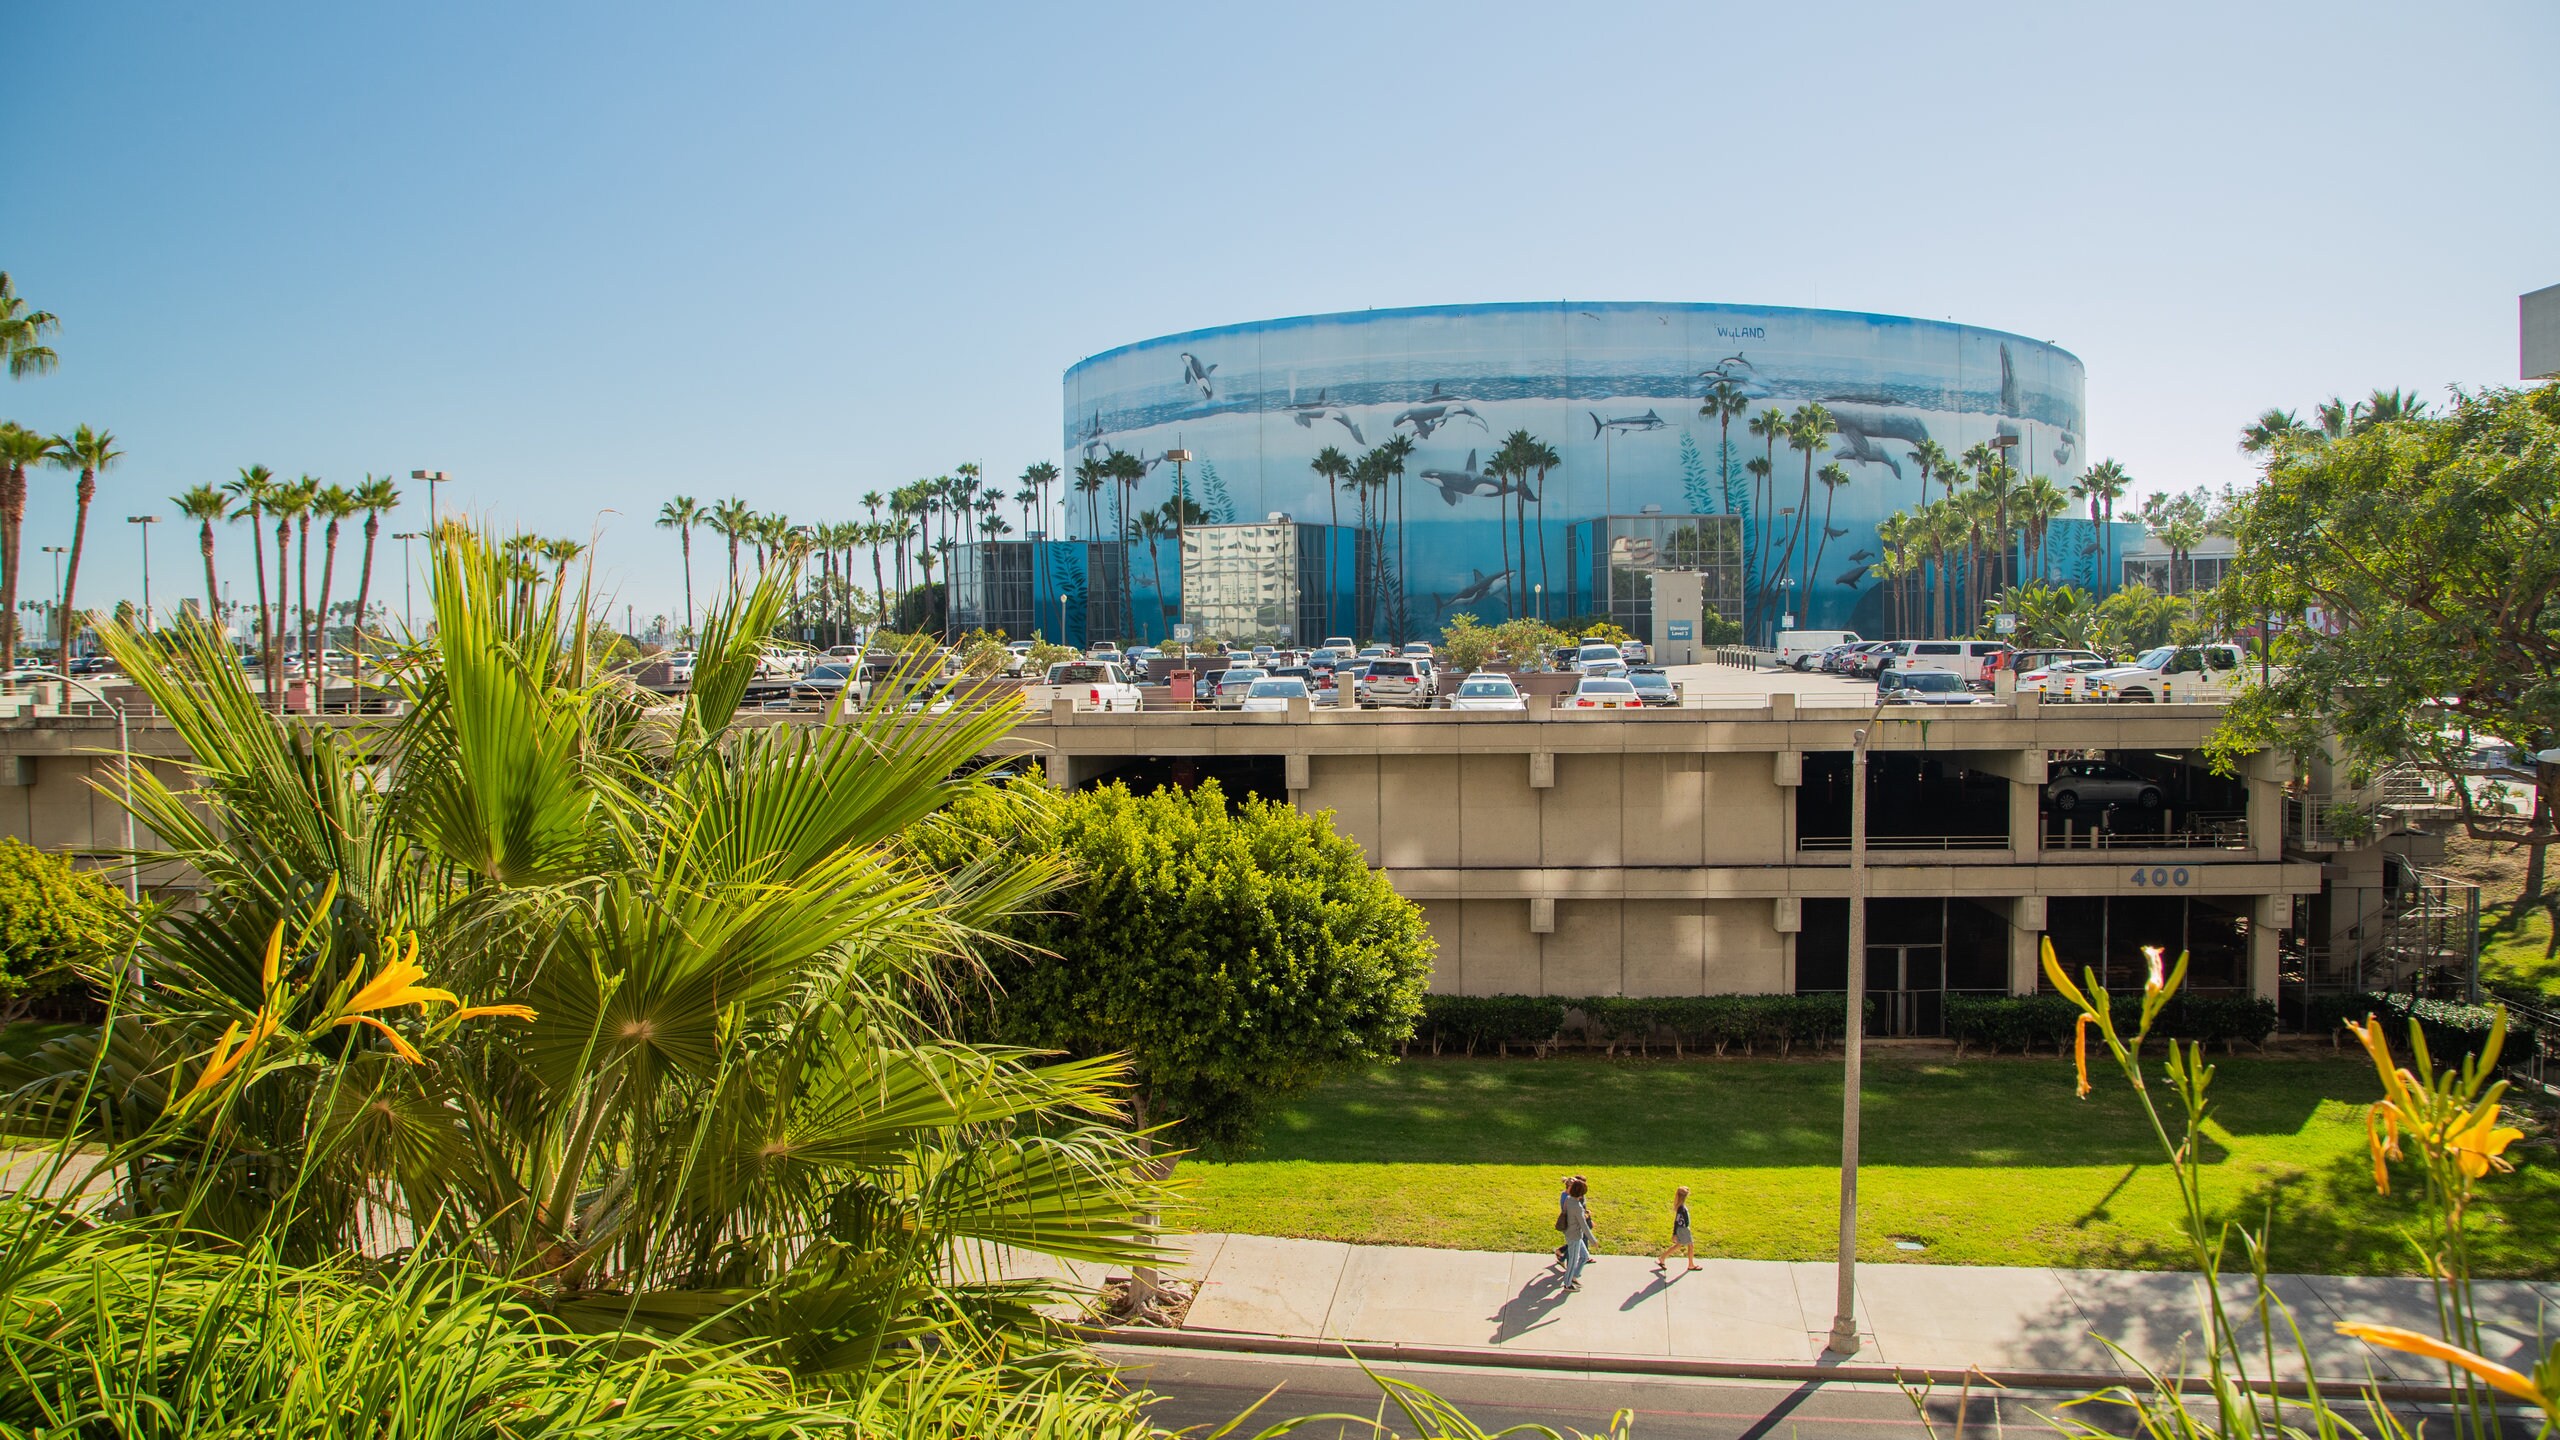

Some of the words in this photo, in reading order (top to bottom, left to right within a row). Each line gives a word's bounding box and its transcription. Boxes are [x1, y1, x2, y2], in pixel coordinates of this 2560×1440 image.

[1998, 618, 2013, 629] 3D
[1175, 628, 1191, 639] 3D
[2130, 867, 2189, 887] 400
